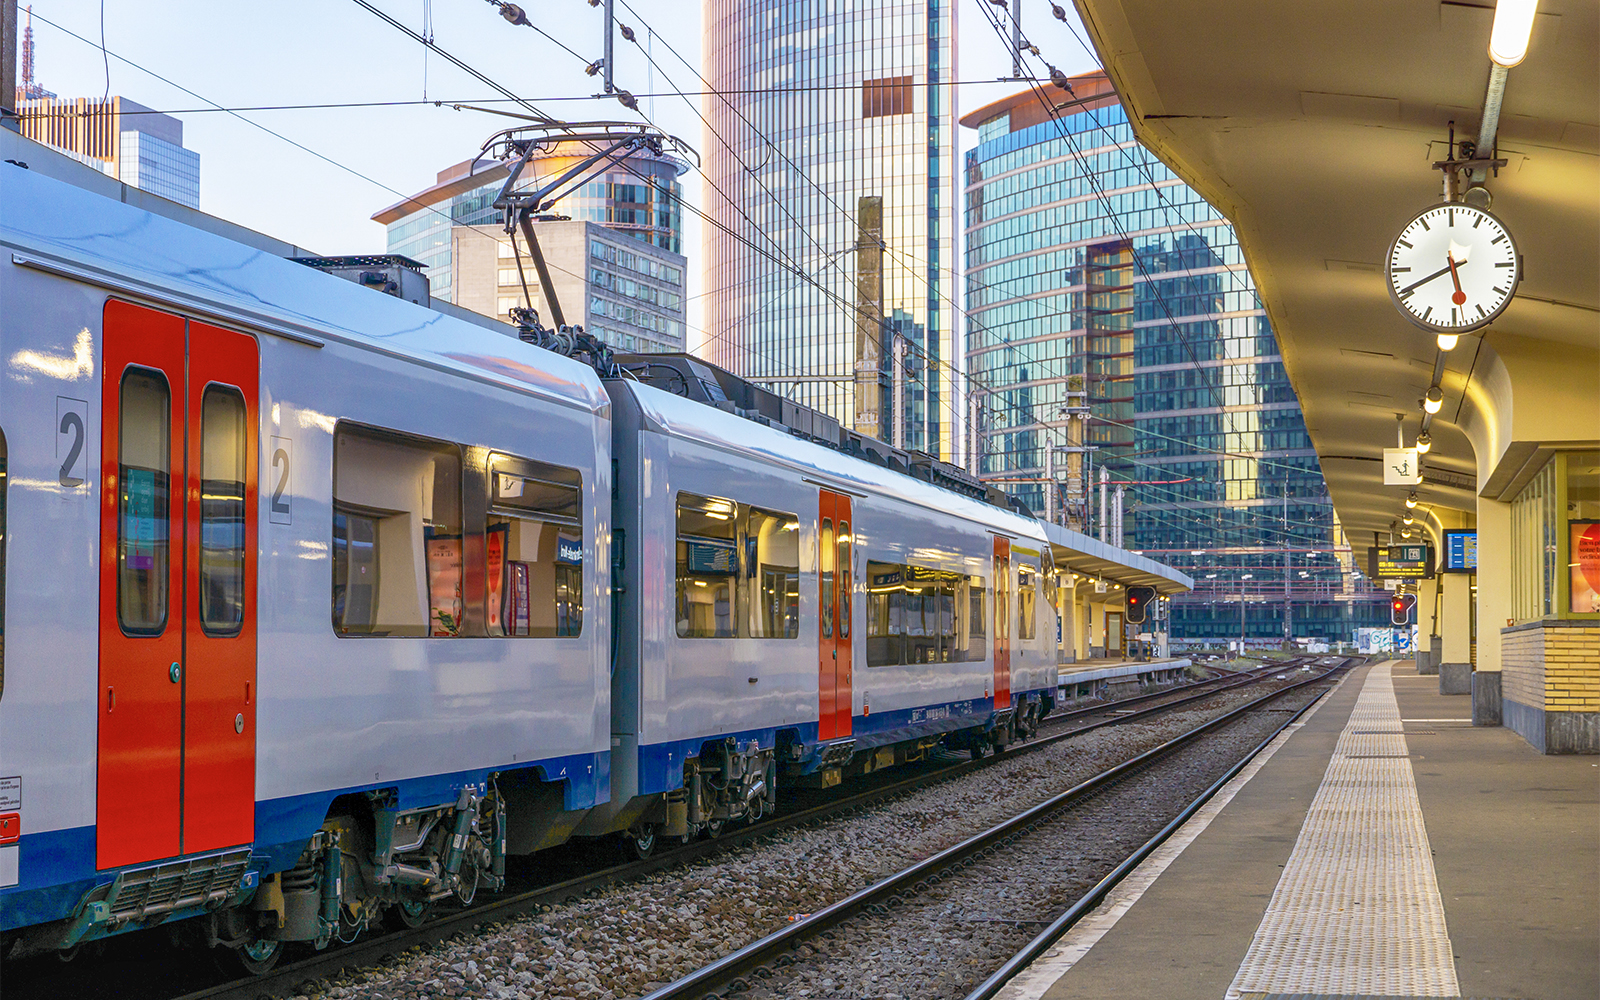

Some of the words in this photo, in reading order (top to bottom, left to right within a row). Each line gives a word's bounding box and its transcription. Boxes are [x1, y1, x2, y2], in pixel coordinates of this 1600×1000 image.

[59, 412, 84, 488] 2
[272, 448, 290, 514] 2
[811, 541, 816, 575] 2
[854, 549, 859, 580] 2
